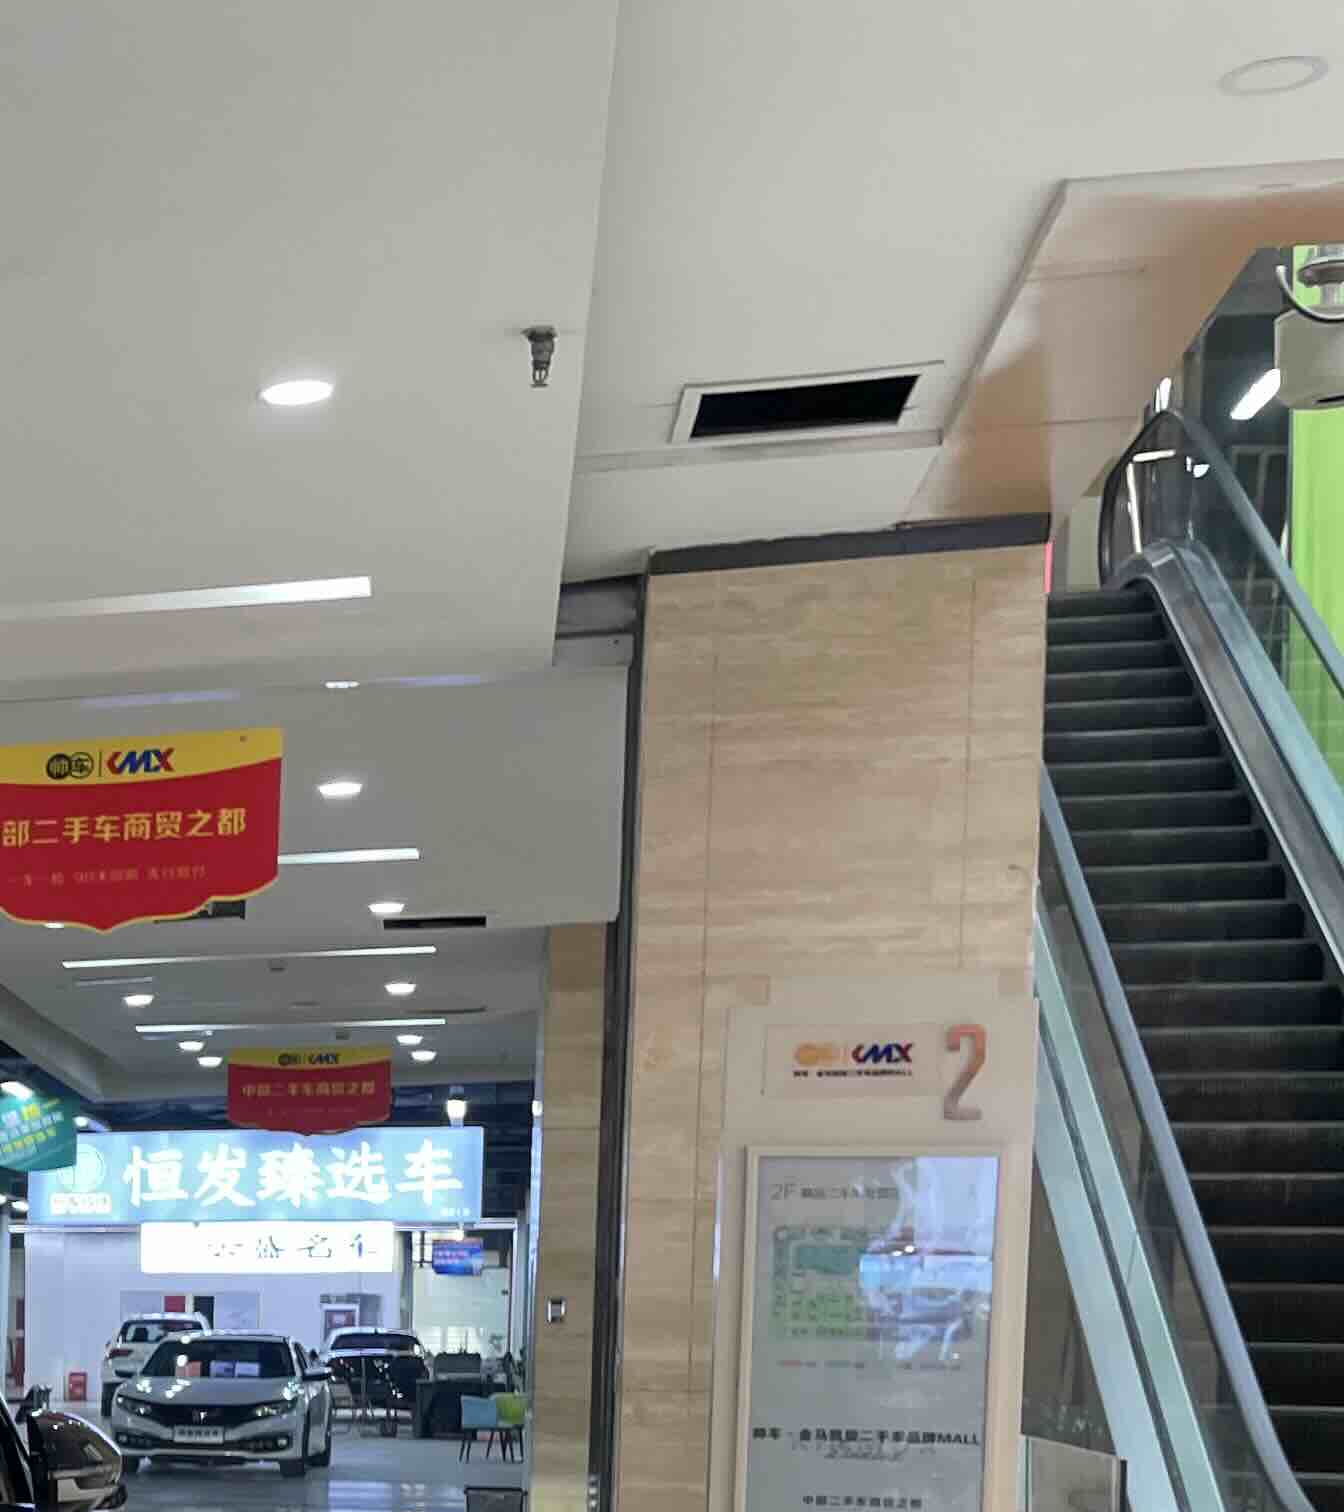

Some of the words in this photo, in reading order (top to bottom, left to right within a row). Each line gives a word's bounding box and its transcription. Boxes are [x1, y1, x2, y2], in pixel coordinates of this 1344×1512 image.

[943, 1023, 987, 1121] 2
[122, 1138, 464, 1207] 恒发臻选车
